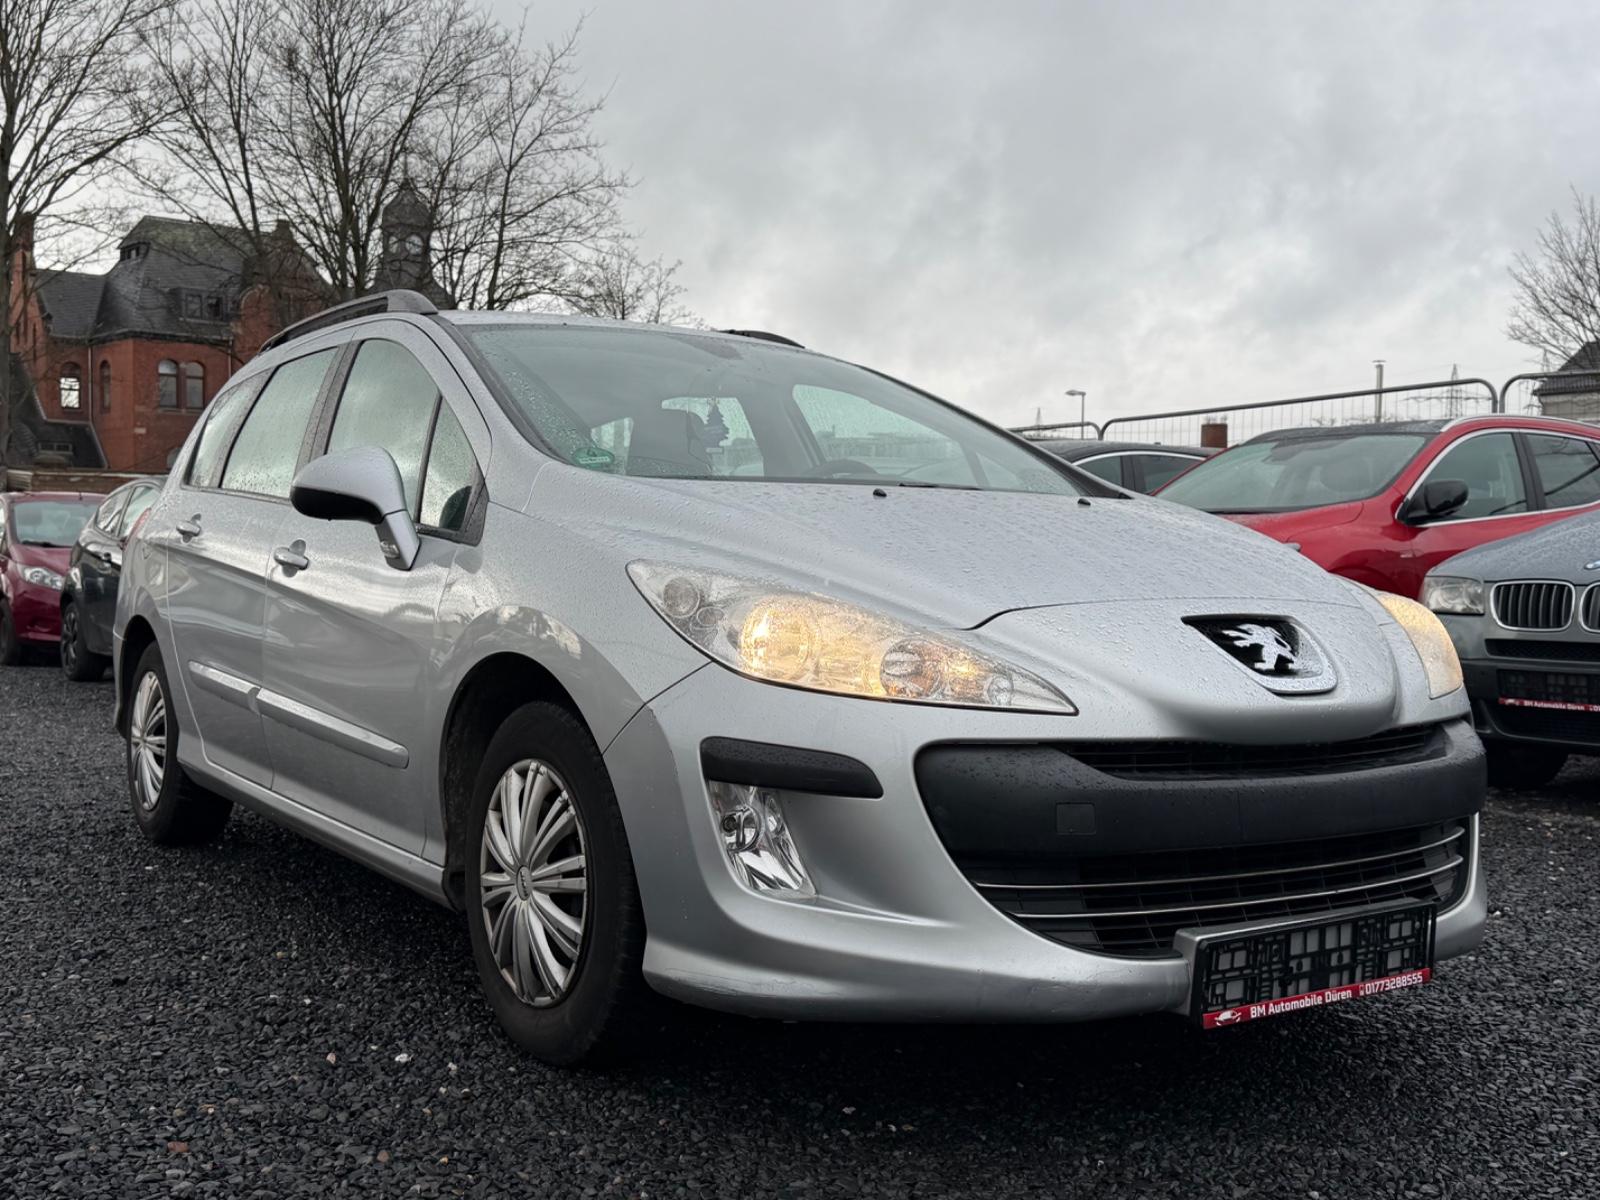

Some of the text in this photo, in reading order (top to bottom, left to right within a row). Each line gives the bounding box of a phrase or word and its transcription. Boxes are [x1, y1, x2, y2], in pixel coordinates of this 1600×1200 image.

[1250, 972, 1423, 1019] BM Automobile Düren 01773288555
